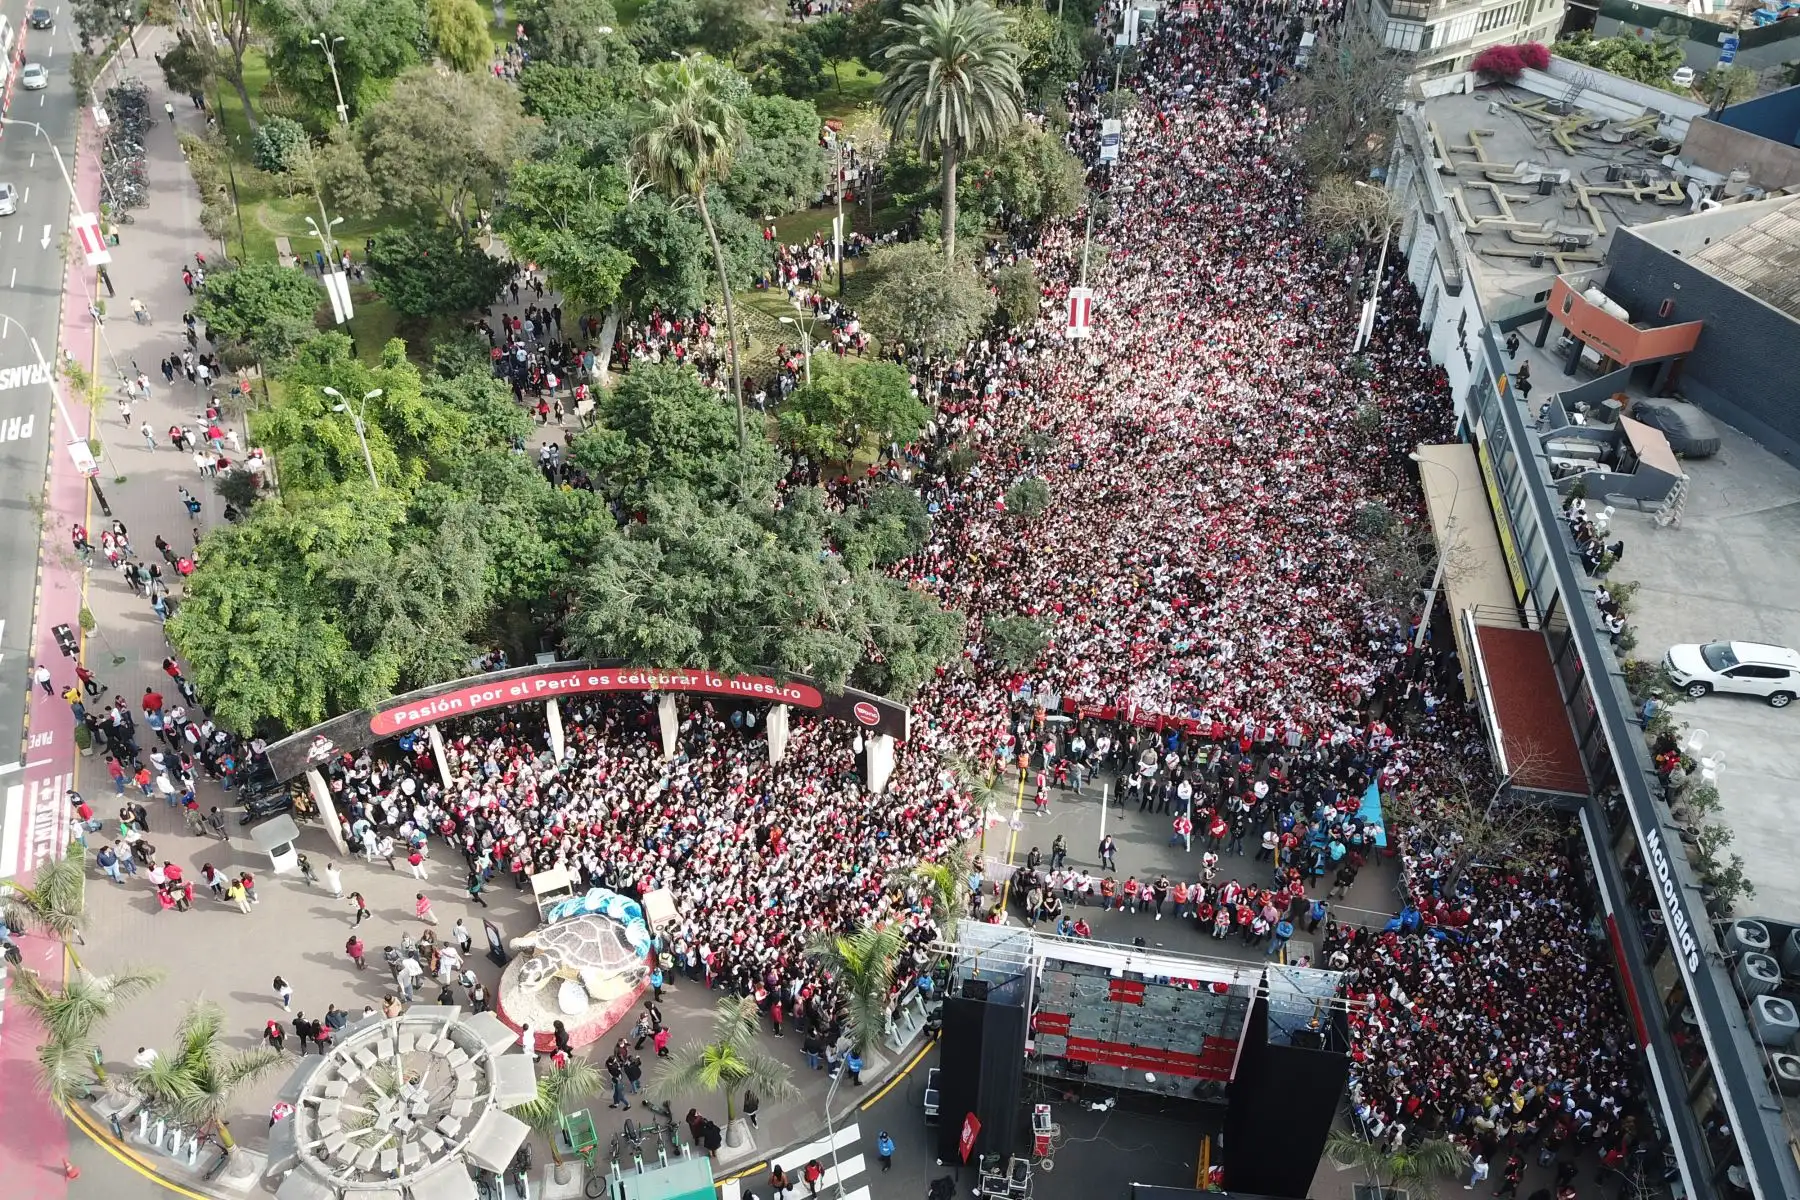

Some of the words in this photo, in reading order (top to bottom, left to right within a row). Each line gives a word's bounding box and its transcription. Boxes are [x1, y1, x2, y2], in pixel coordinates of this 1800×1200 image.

[393, 696, 463, 725] Pasión
[469, 688, 503, 707] por
[510, 682, 529, 696] el
[535, 674, 581, 692] Perú
[588, 675, 610, 686] es
[617, 673, 699, 686] celebrar
[705, 674, 723, 688] lo
[730, 679, 801, 699] nuestro
[1646, 828, 1700, 974] McDonald's
